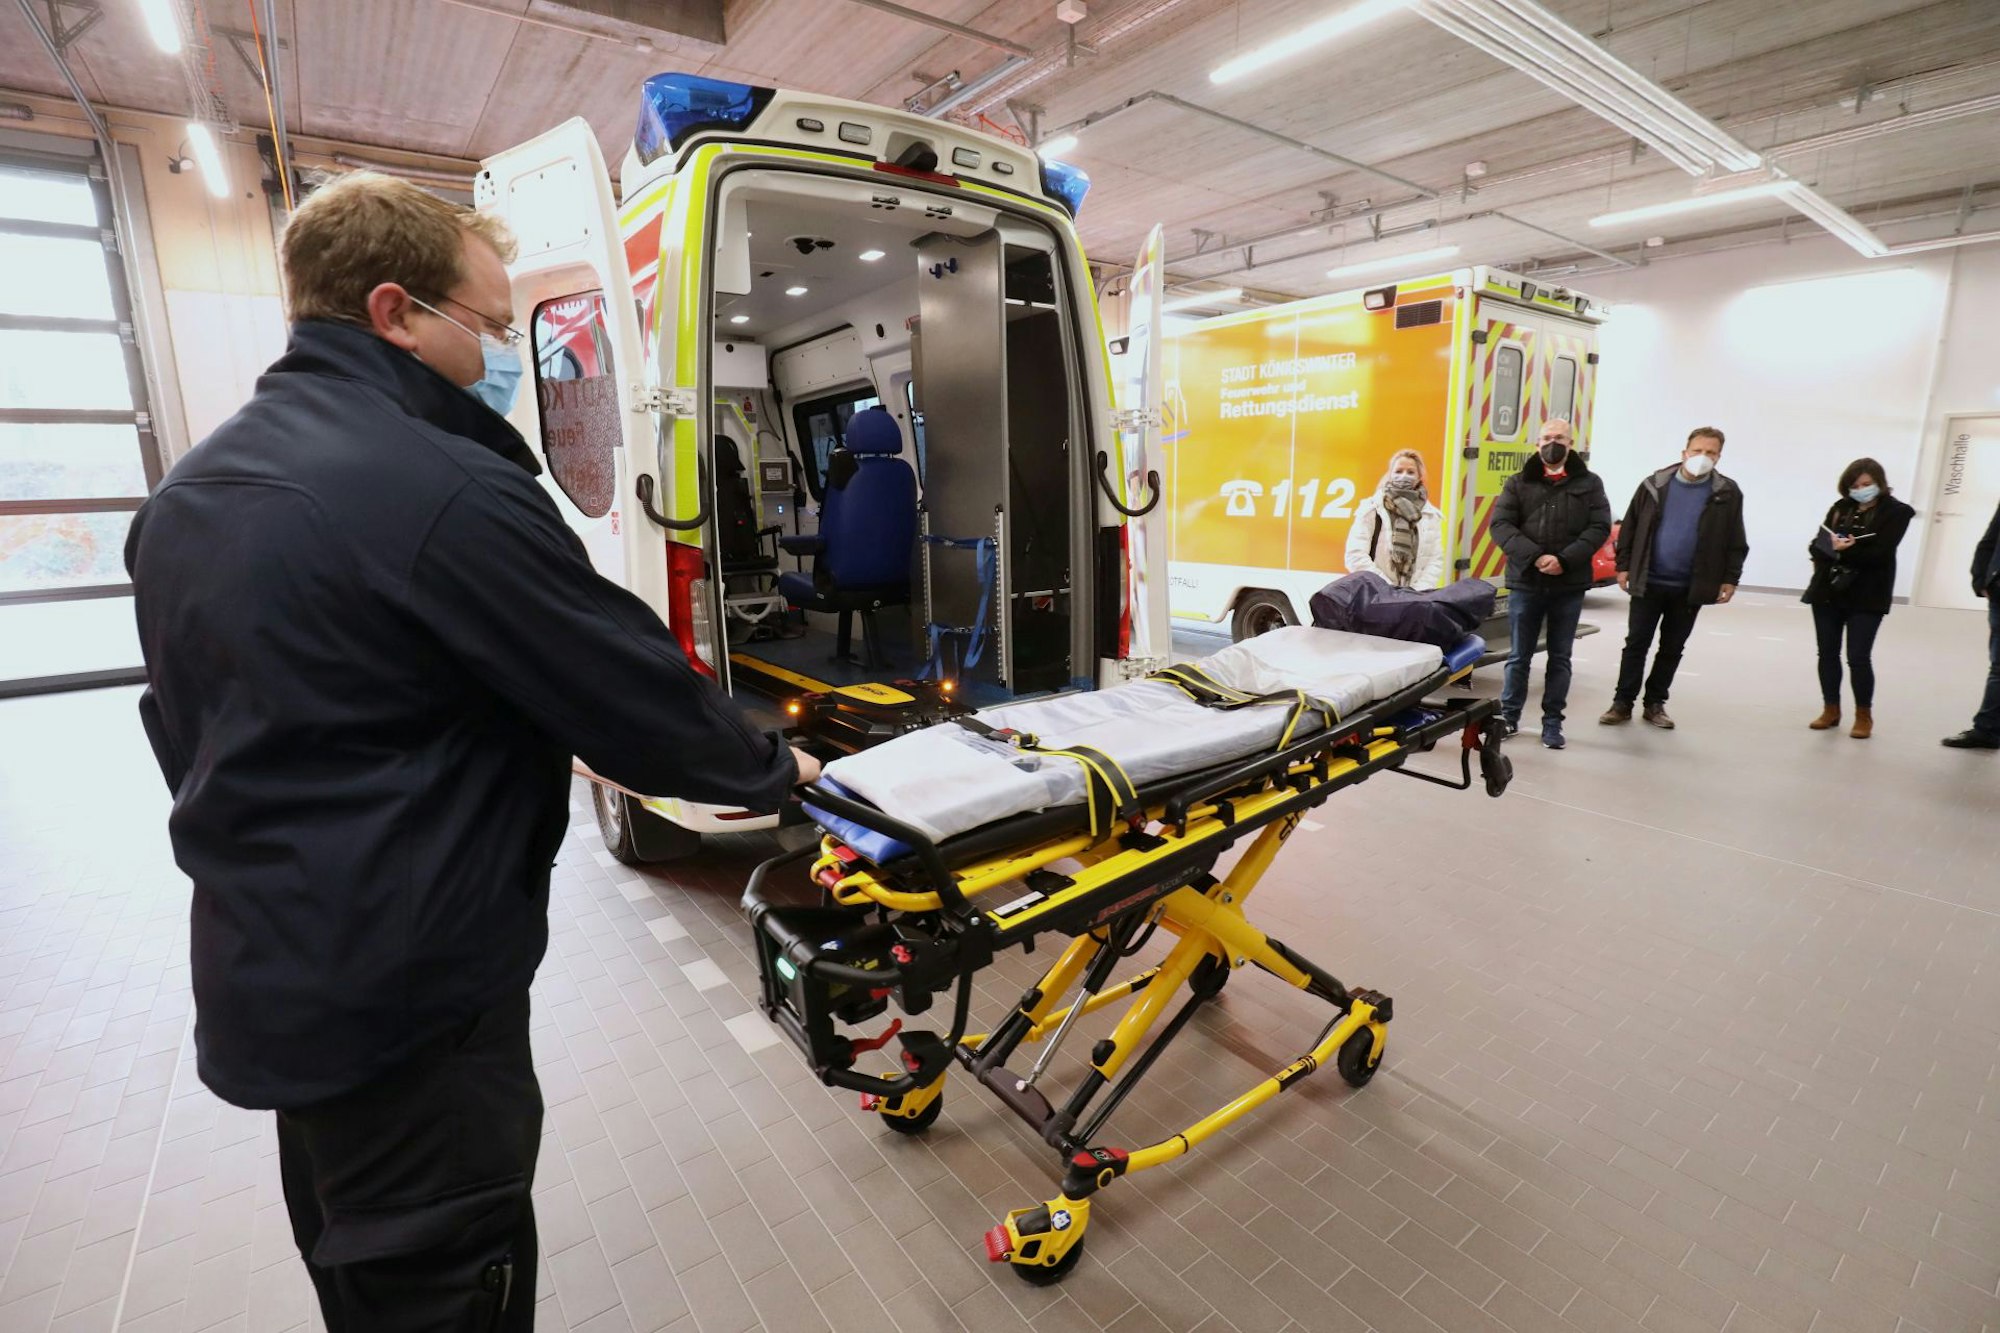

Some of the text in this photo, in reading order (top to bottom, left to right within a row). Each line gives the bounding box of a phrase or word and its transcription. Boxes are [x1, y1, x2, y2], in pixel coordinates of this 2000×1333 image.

[1221, 352, 1357, 384] STADT KÖNIGSWINTER
[1220, 379, 1307, 399] Feuerwehr und
[1220, 390, 1359, 418] Rettungsdienst
[1944, 433, 1971, 495] Waschhalle
[1270, 478, 1356, 519] 112
